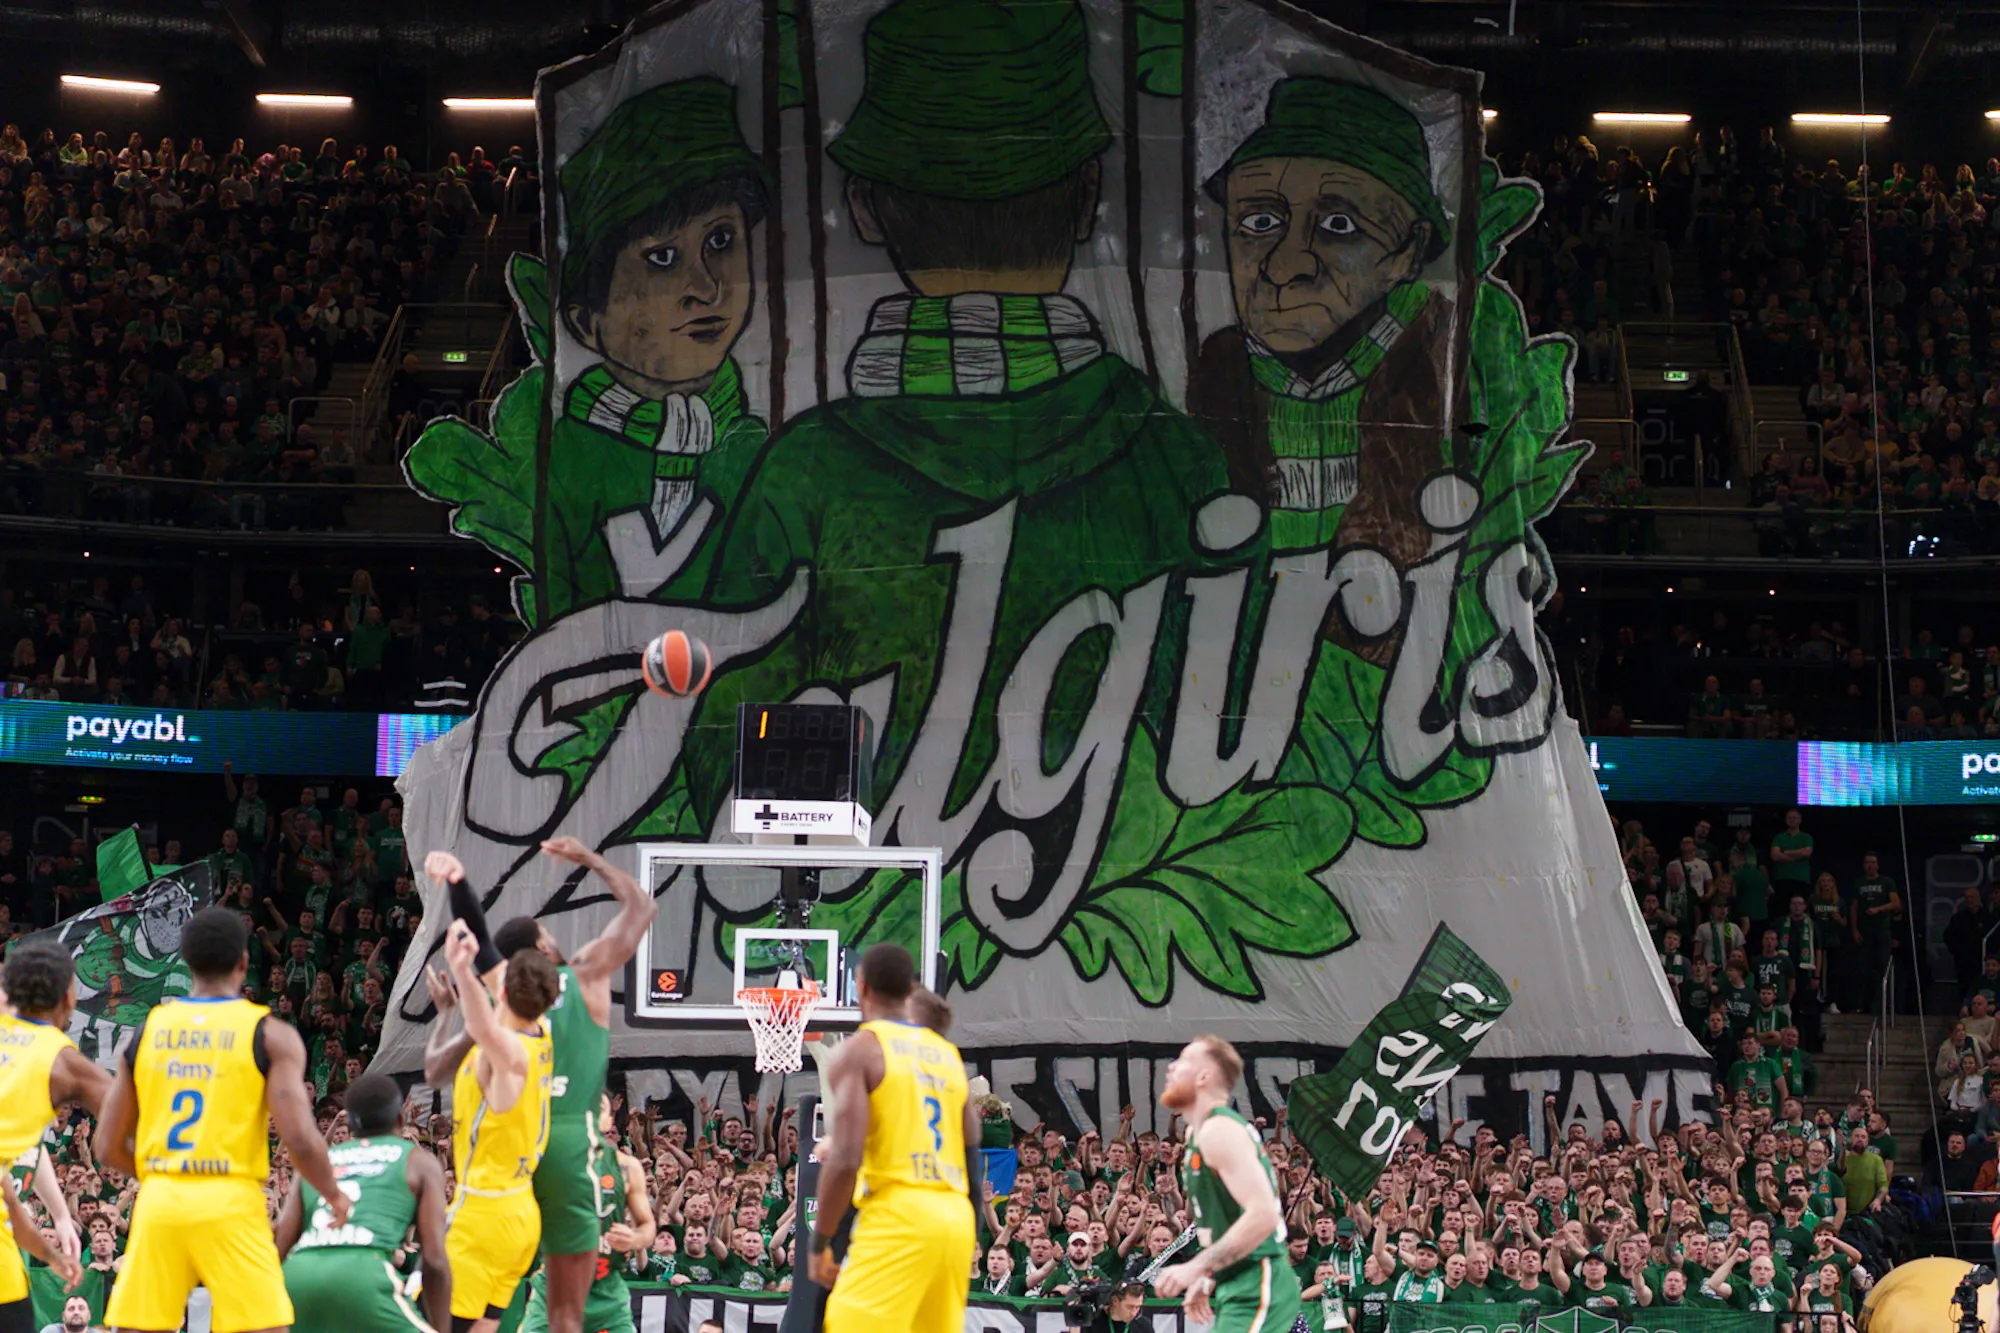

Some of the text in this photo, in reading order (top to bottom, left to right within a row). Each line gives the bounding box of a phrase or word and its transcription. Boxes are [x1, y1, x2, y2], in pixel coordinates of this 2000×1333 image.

[65, 747, 194, 765] Activate your money flow
[1961, 785, 2000, 797] Activat
[781, 812, 834, 822] BATTERY
[155, 1029, 213, 1050] CLARK
[167, 1089, 204, 1151] 2
[924, 1096, 942, 1151] 3
